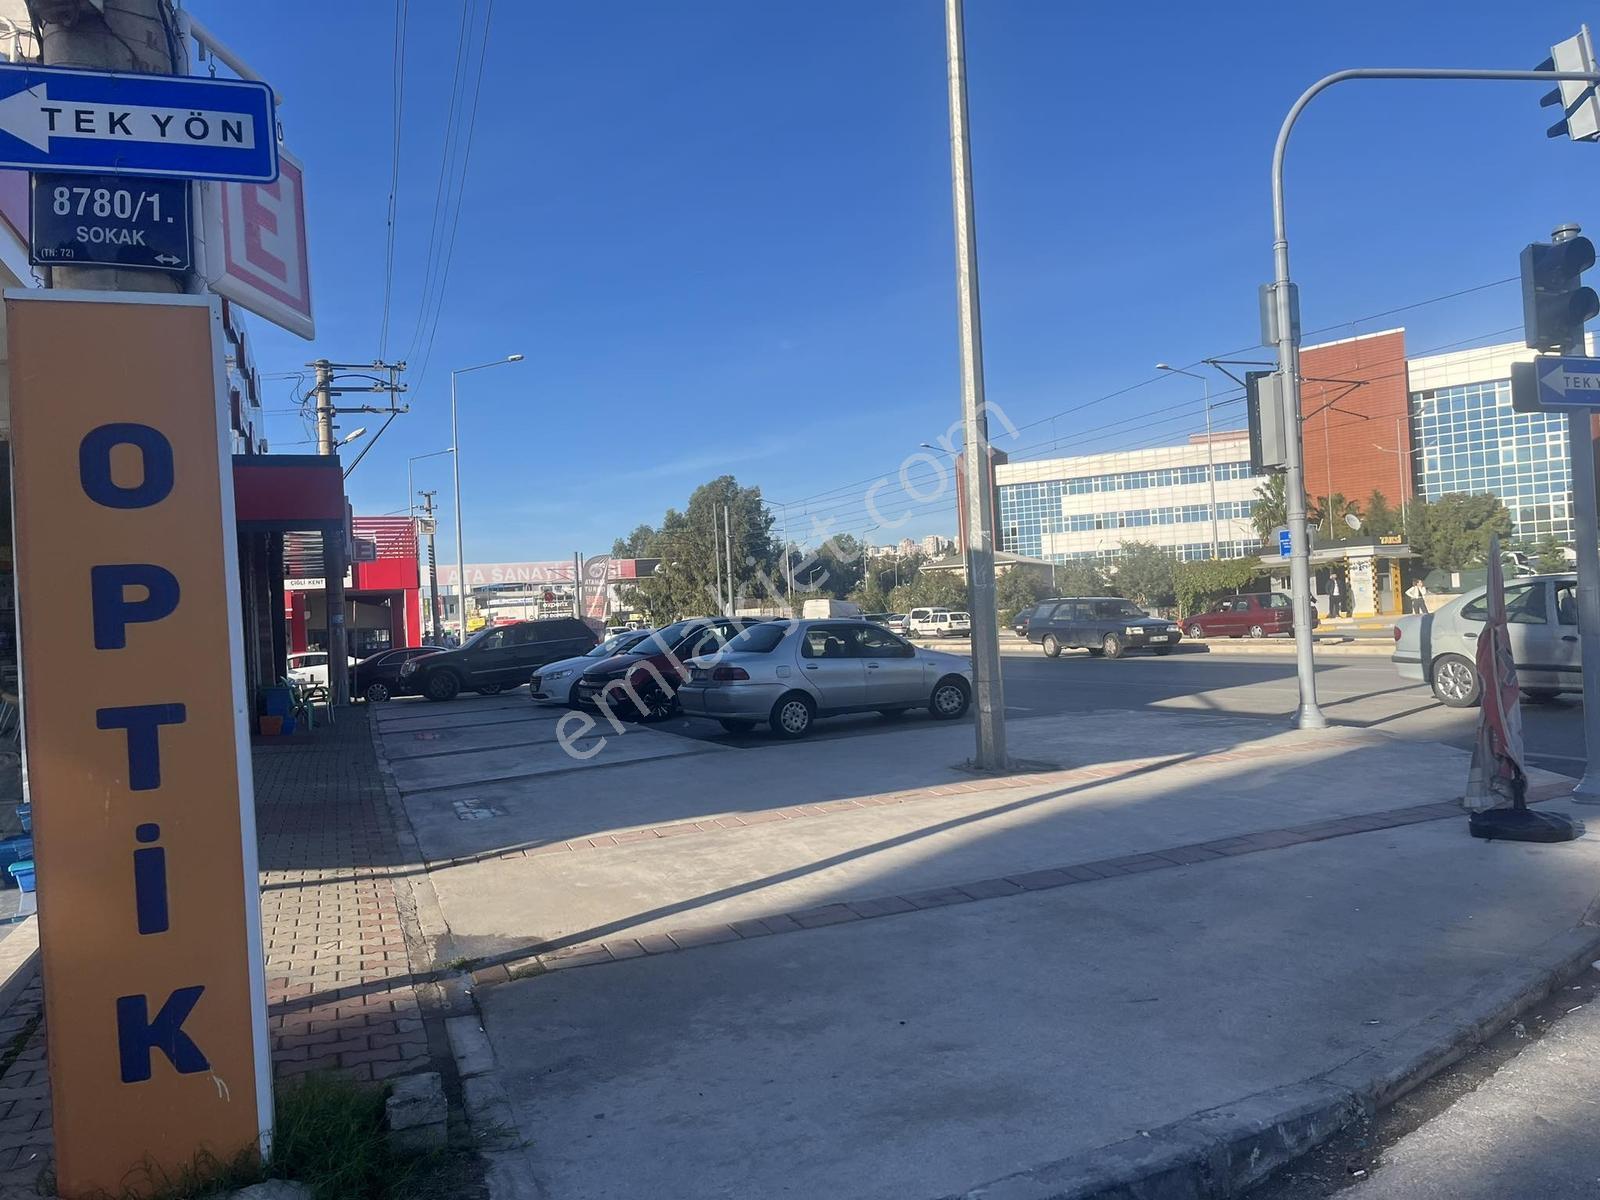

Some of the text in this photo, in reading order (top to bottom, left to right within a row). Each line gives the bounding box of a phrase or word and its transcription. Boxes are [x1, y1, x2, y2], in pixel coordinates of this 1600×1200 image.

[40, 107, 243, 143] TEK YÖN
[53, 186, 174, 223] 8780/1.
[76, 226, 146, 246] SOKAK
[60, 248, 74, 258] 72)
[1563, 376, 1591, 388] TEK
[448, 569, 485, 584] ATA
